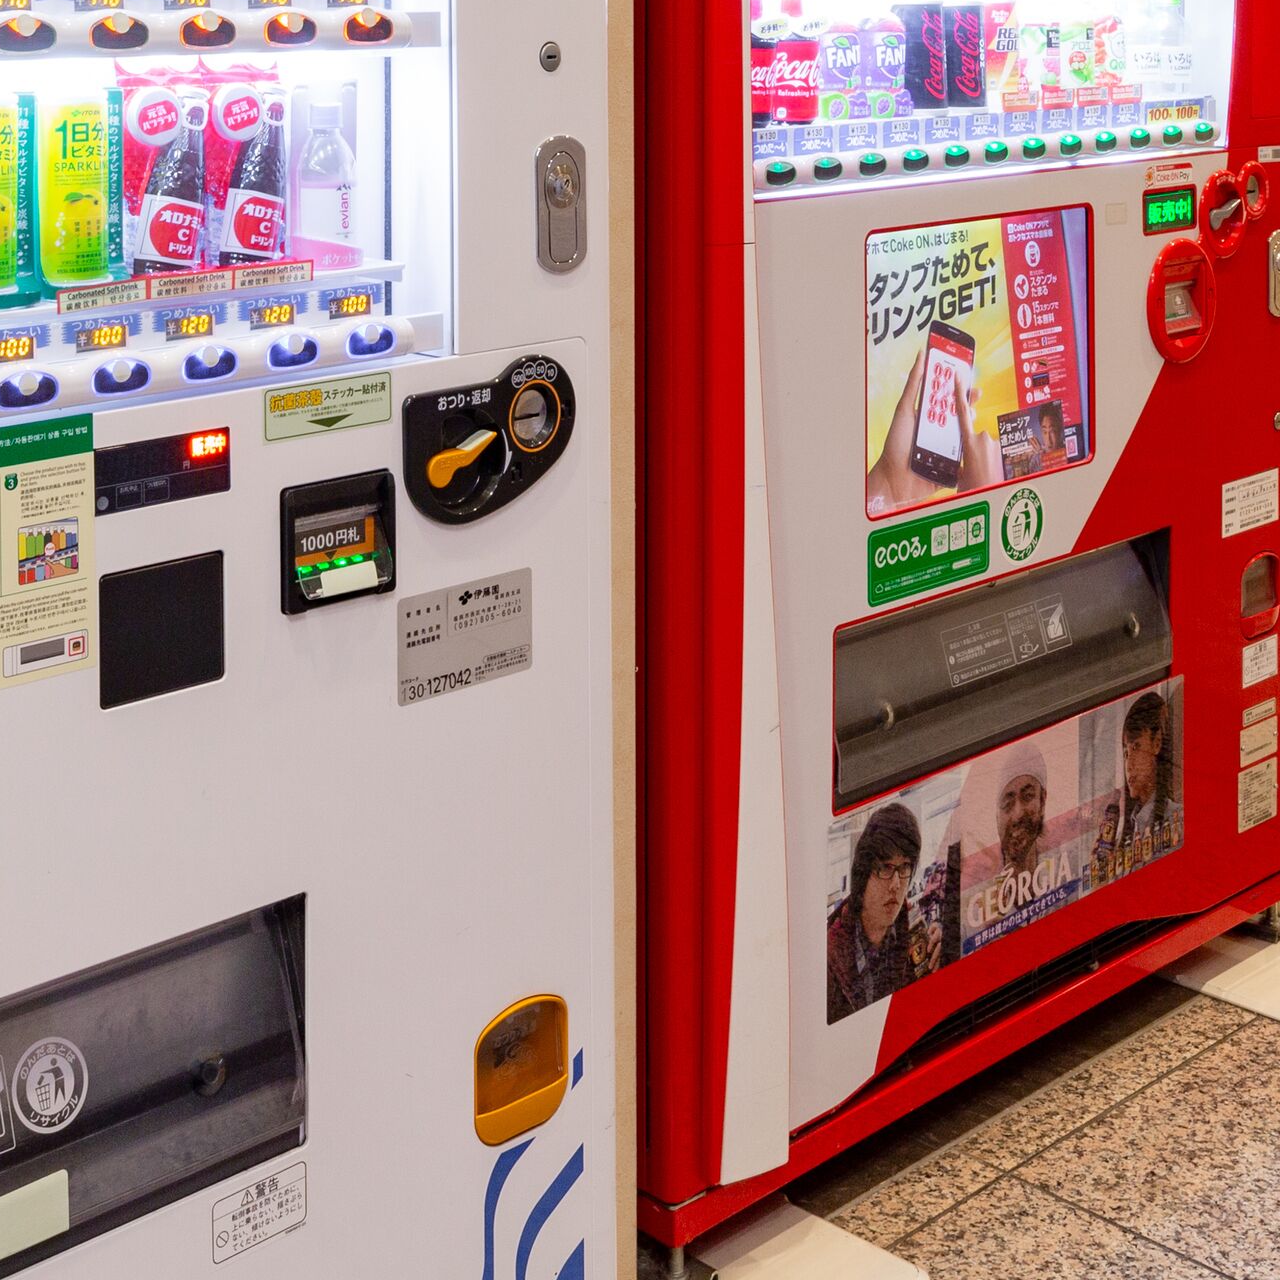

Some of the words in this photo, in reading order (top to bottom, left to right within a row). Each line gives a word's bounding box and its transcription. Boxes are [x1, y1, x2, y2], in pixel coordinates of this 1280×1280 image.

[147, 106, 167, 119] 元気
[18, 107, 29, 230] 11種のマルチビタミン炭酸
[108, 104, 120, 224] 11種のマルチビタミン炭酸
[1179, 172, 1190, 181] Pay
[341, 191, 350, 231] evian
[168, 242, 193, 255] ドリンク
[159, 275, 194, 287] Carbonated
[196, 274, 208, 283] Soft
[209, 273, 225, 281] Drink
[242, 268, 275, 277] Carbonated
[289, 264, 304, 272] Drink
[866, 242, 996, 306] タンプためて、
[67, 285, 105, 299] Carbonated
[106, 285, 122, 295] Soft
[123, 282, 138, 293] Drink
[1031, 286, 1048, 298] たまる
[866, 275, 996, 346] リンクGET!
[513, 374, 524, 383] 500
[524, 366, 535, 376] 100
[535, 365, 545, 374] 50
[546, 368, 555, 377] 10
[437, 387, 491, 411] おつり・返却
[999, 416, 1030, 434] ジョージア
[191, 434, 226, 457] 販売中
[1005, 489, 1041, 516] のんだあとは
[300, 527, 361, 554] 1000円札
[1007, 537, 1038, 560] リサイクル
[967, 849, 1072, 928] GEORGIA
[20, 1042, 76, 1080] のんだあとは
[29, 1095, 78, 1127] リサイクル
[256, 1177, 279, 1199] 警告
